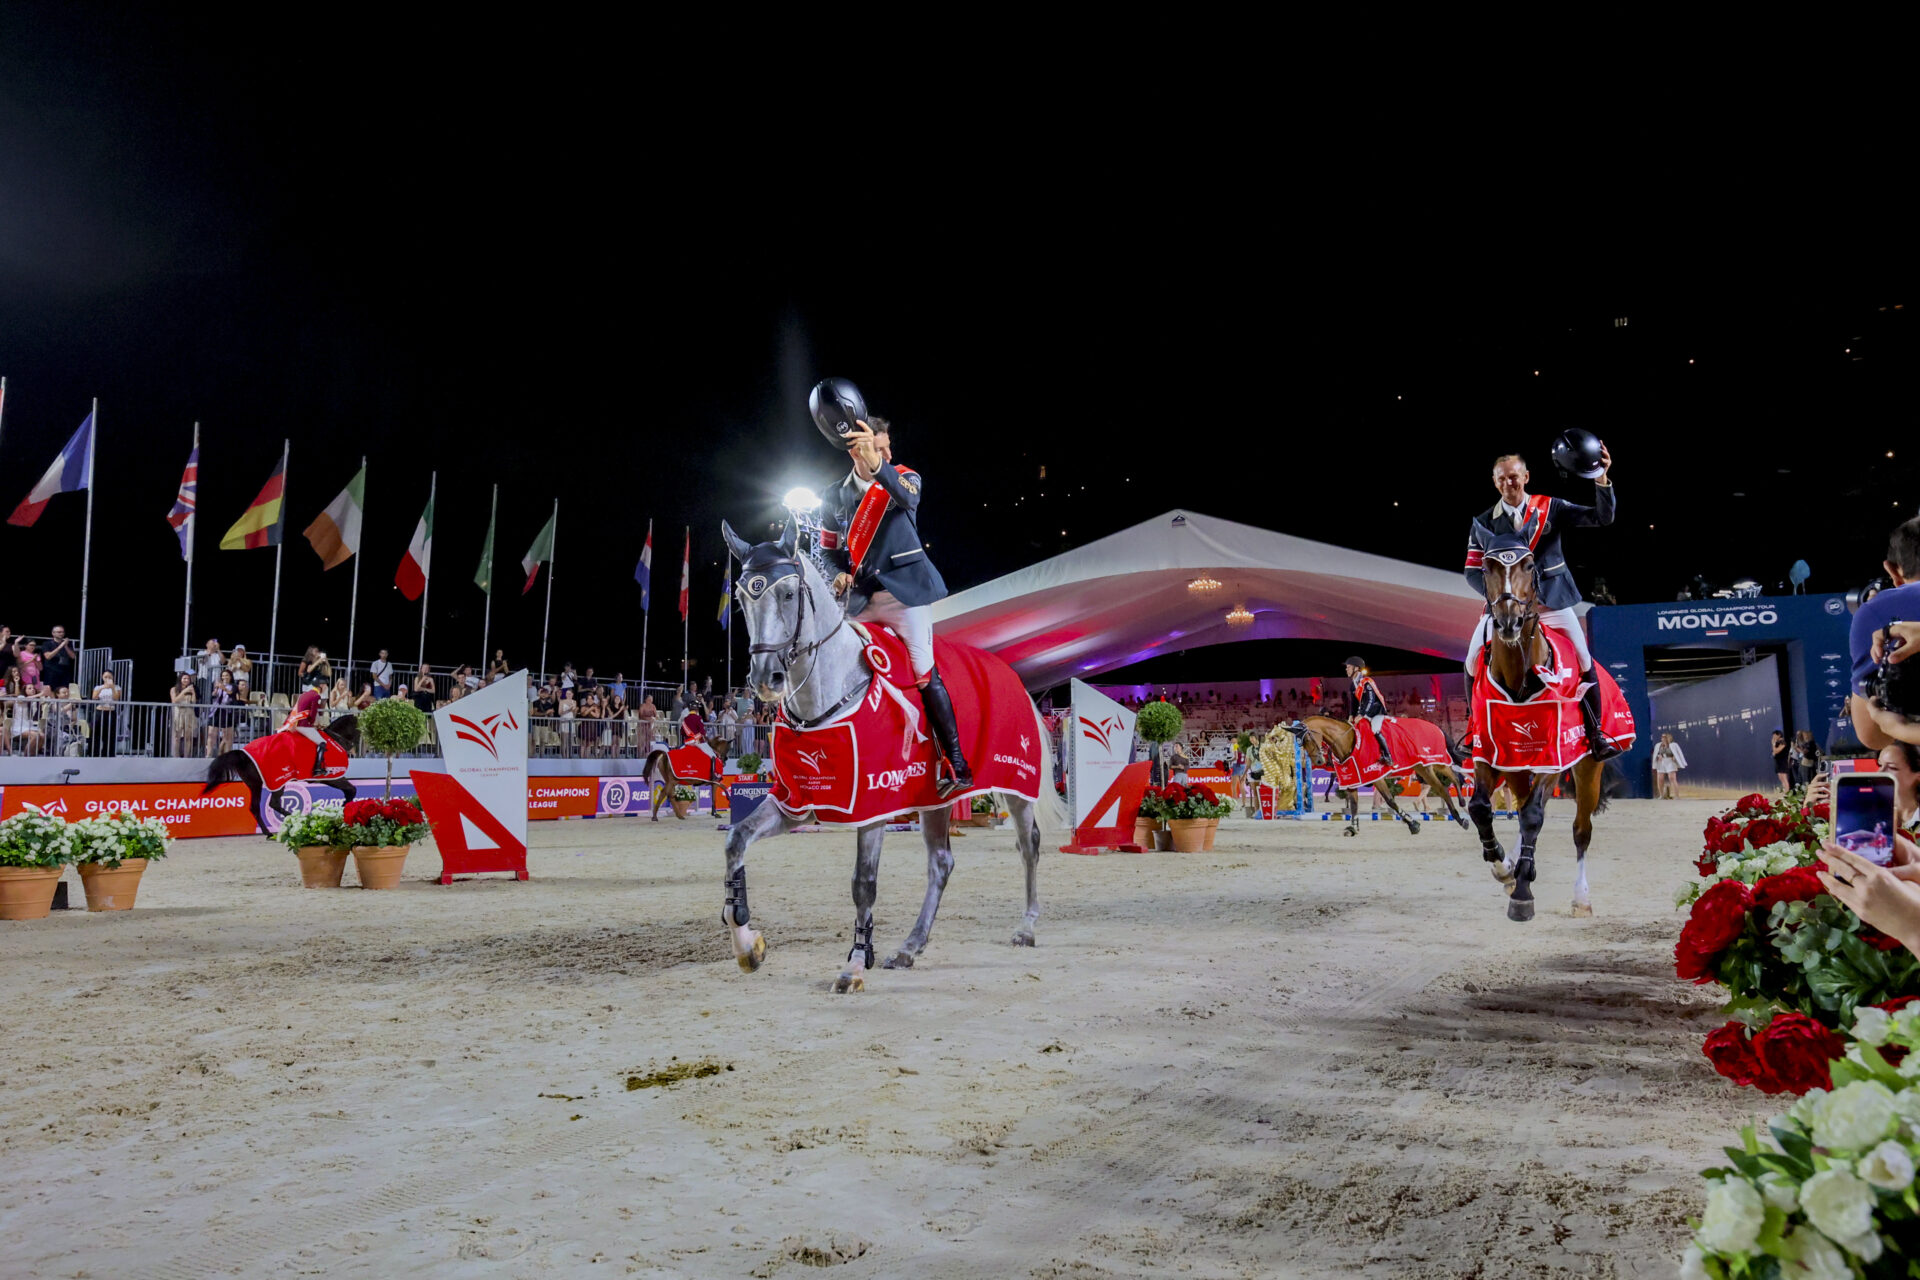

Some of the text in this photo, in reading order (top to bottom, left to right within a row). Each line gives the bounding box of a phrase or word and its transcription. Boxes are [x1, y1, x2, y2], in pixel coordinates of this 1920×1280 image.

[1658, 610, 1778, 630] MONACO
[536, 788, 590, 797] CHAMPIONS
[85, 796, 245, 812] GLOBAL CHAMPIONS
